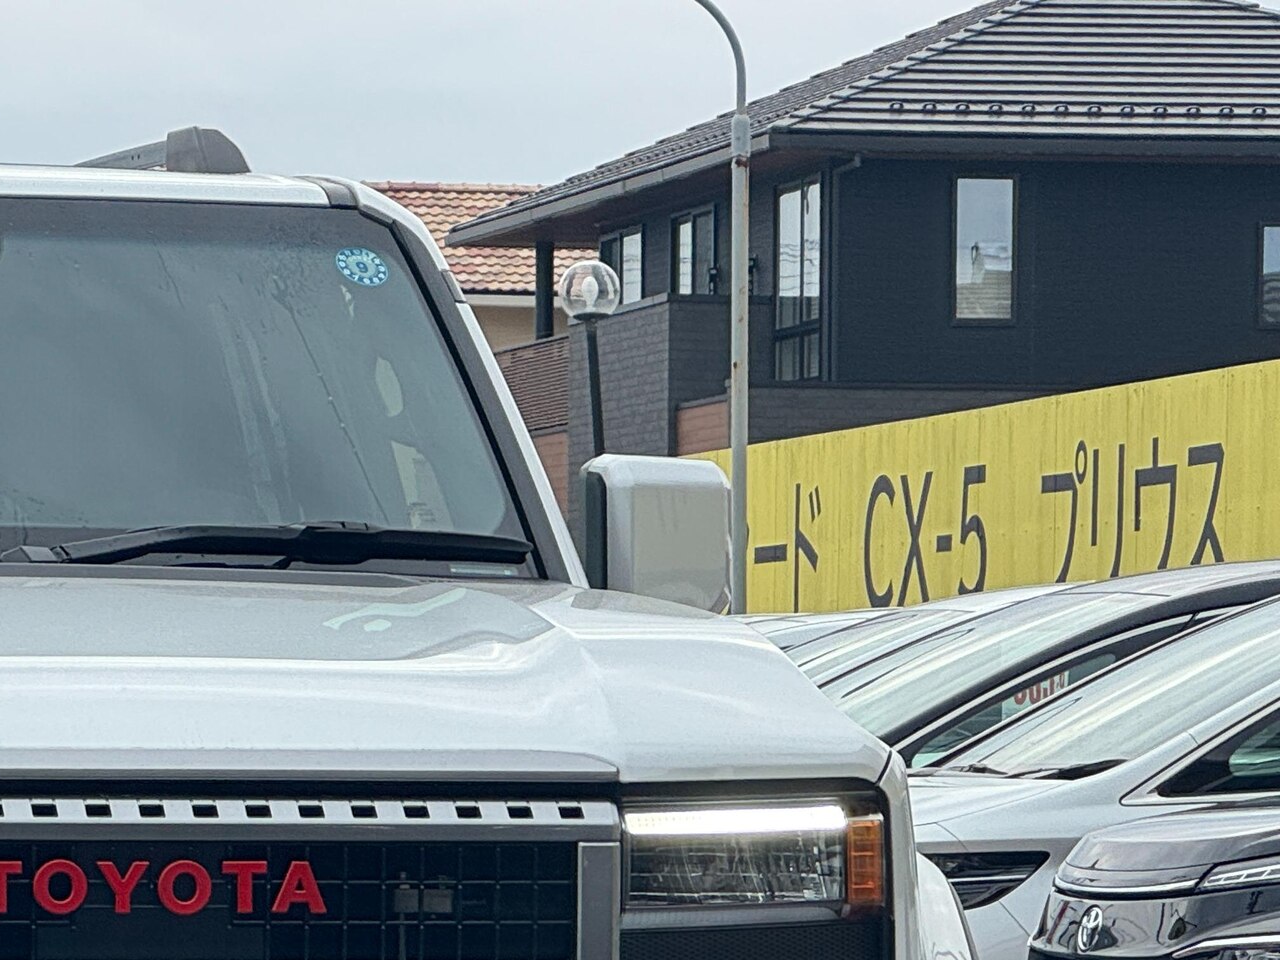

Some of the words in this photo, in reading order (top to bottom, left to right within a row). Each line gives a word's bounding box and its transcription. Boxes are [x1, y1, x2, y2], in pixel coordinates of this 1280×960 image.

[746, 483, 821, 613] ード
[864, 464, 987, 608] CX-5
[1041, 437, 1225, 583] プリウス
